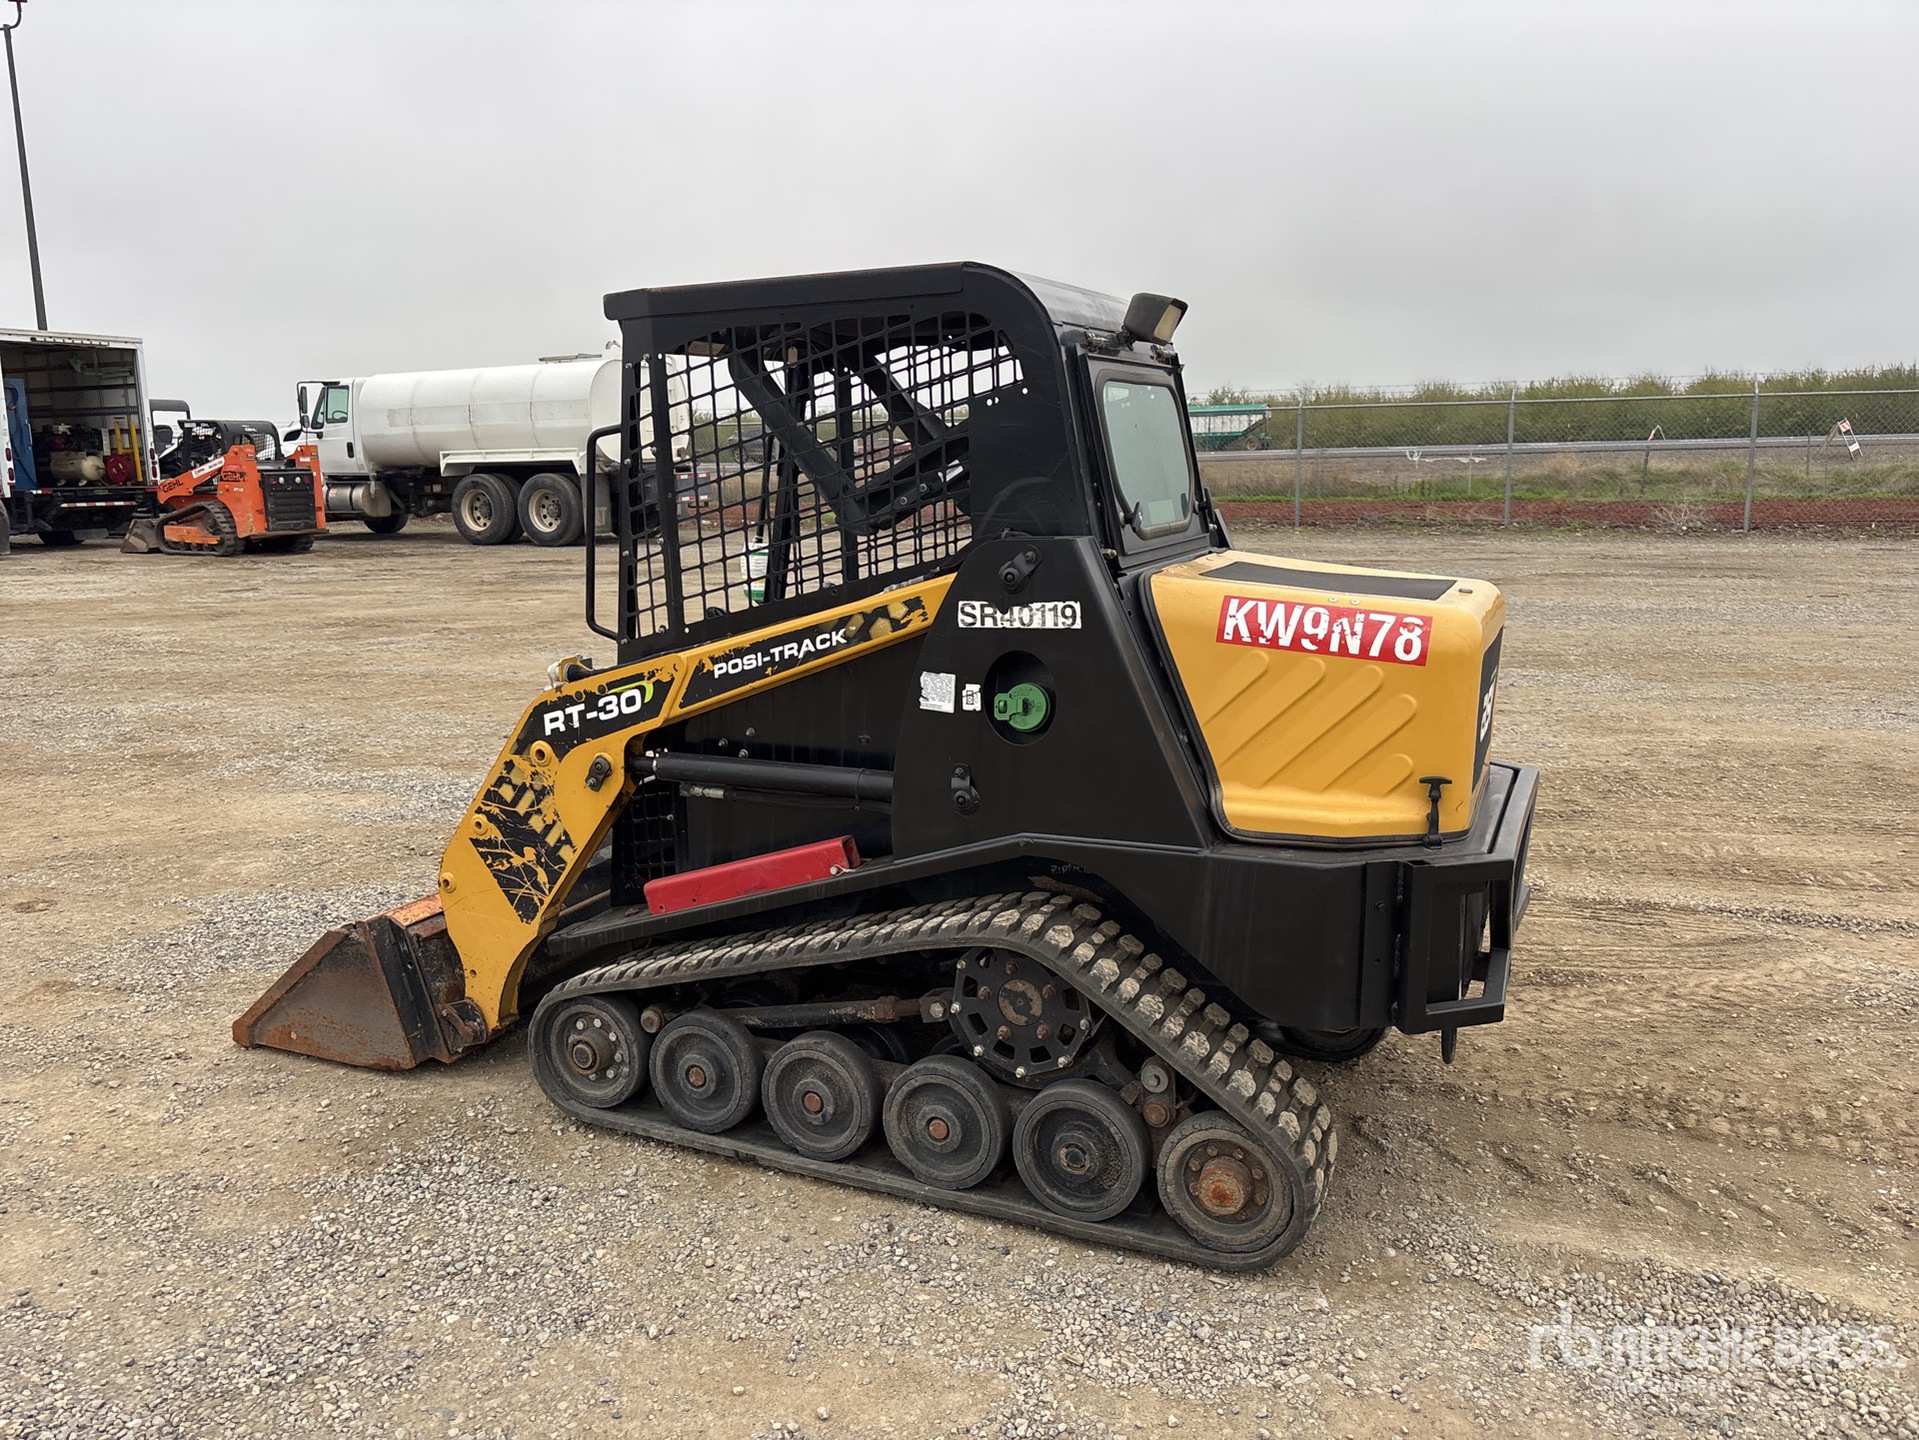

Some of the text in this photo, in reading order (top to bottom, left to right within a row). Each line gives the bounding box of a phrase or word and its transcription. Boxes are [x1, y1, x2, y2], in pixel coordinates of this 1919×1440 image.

[163, 480, 184, 493] GEHL
[960, 603, 1077, 628] SR40119
[1223, 598, 1424, 662] KW9N78
[713, 628, 848, 679] POSI-TRACK
[543, 690, 642, 736] RT-30
